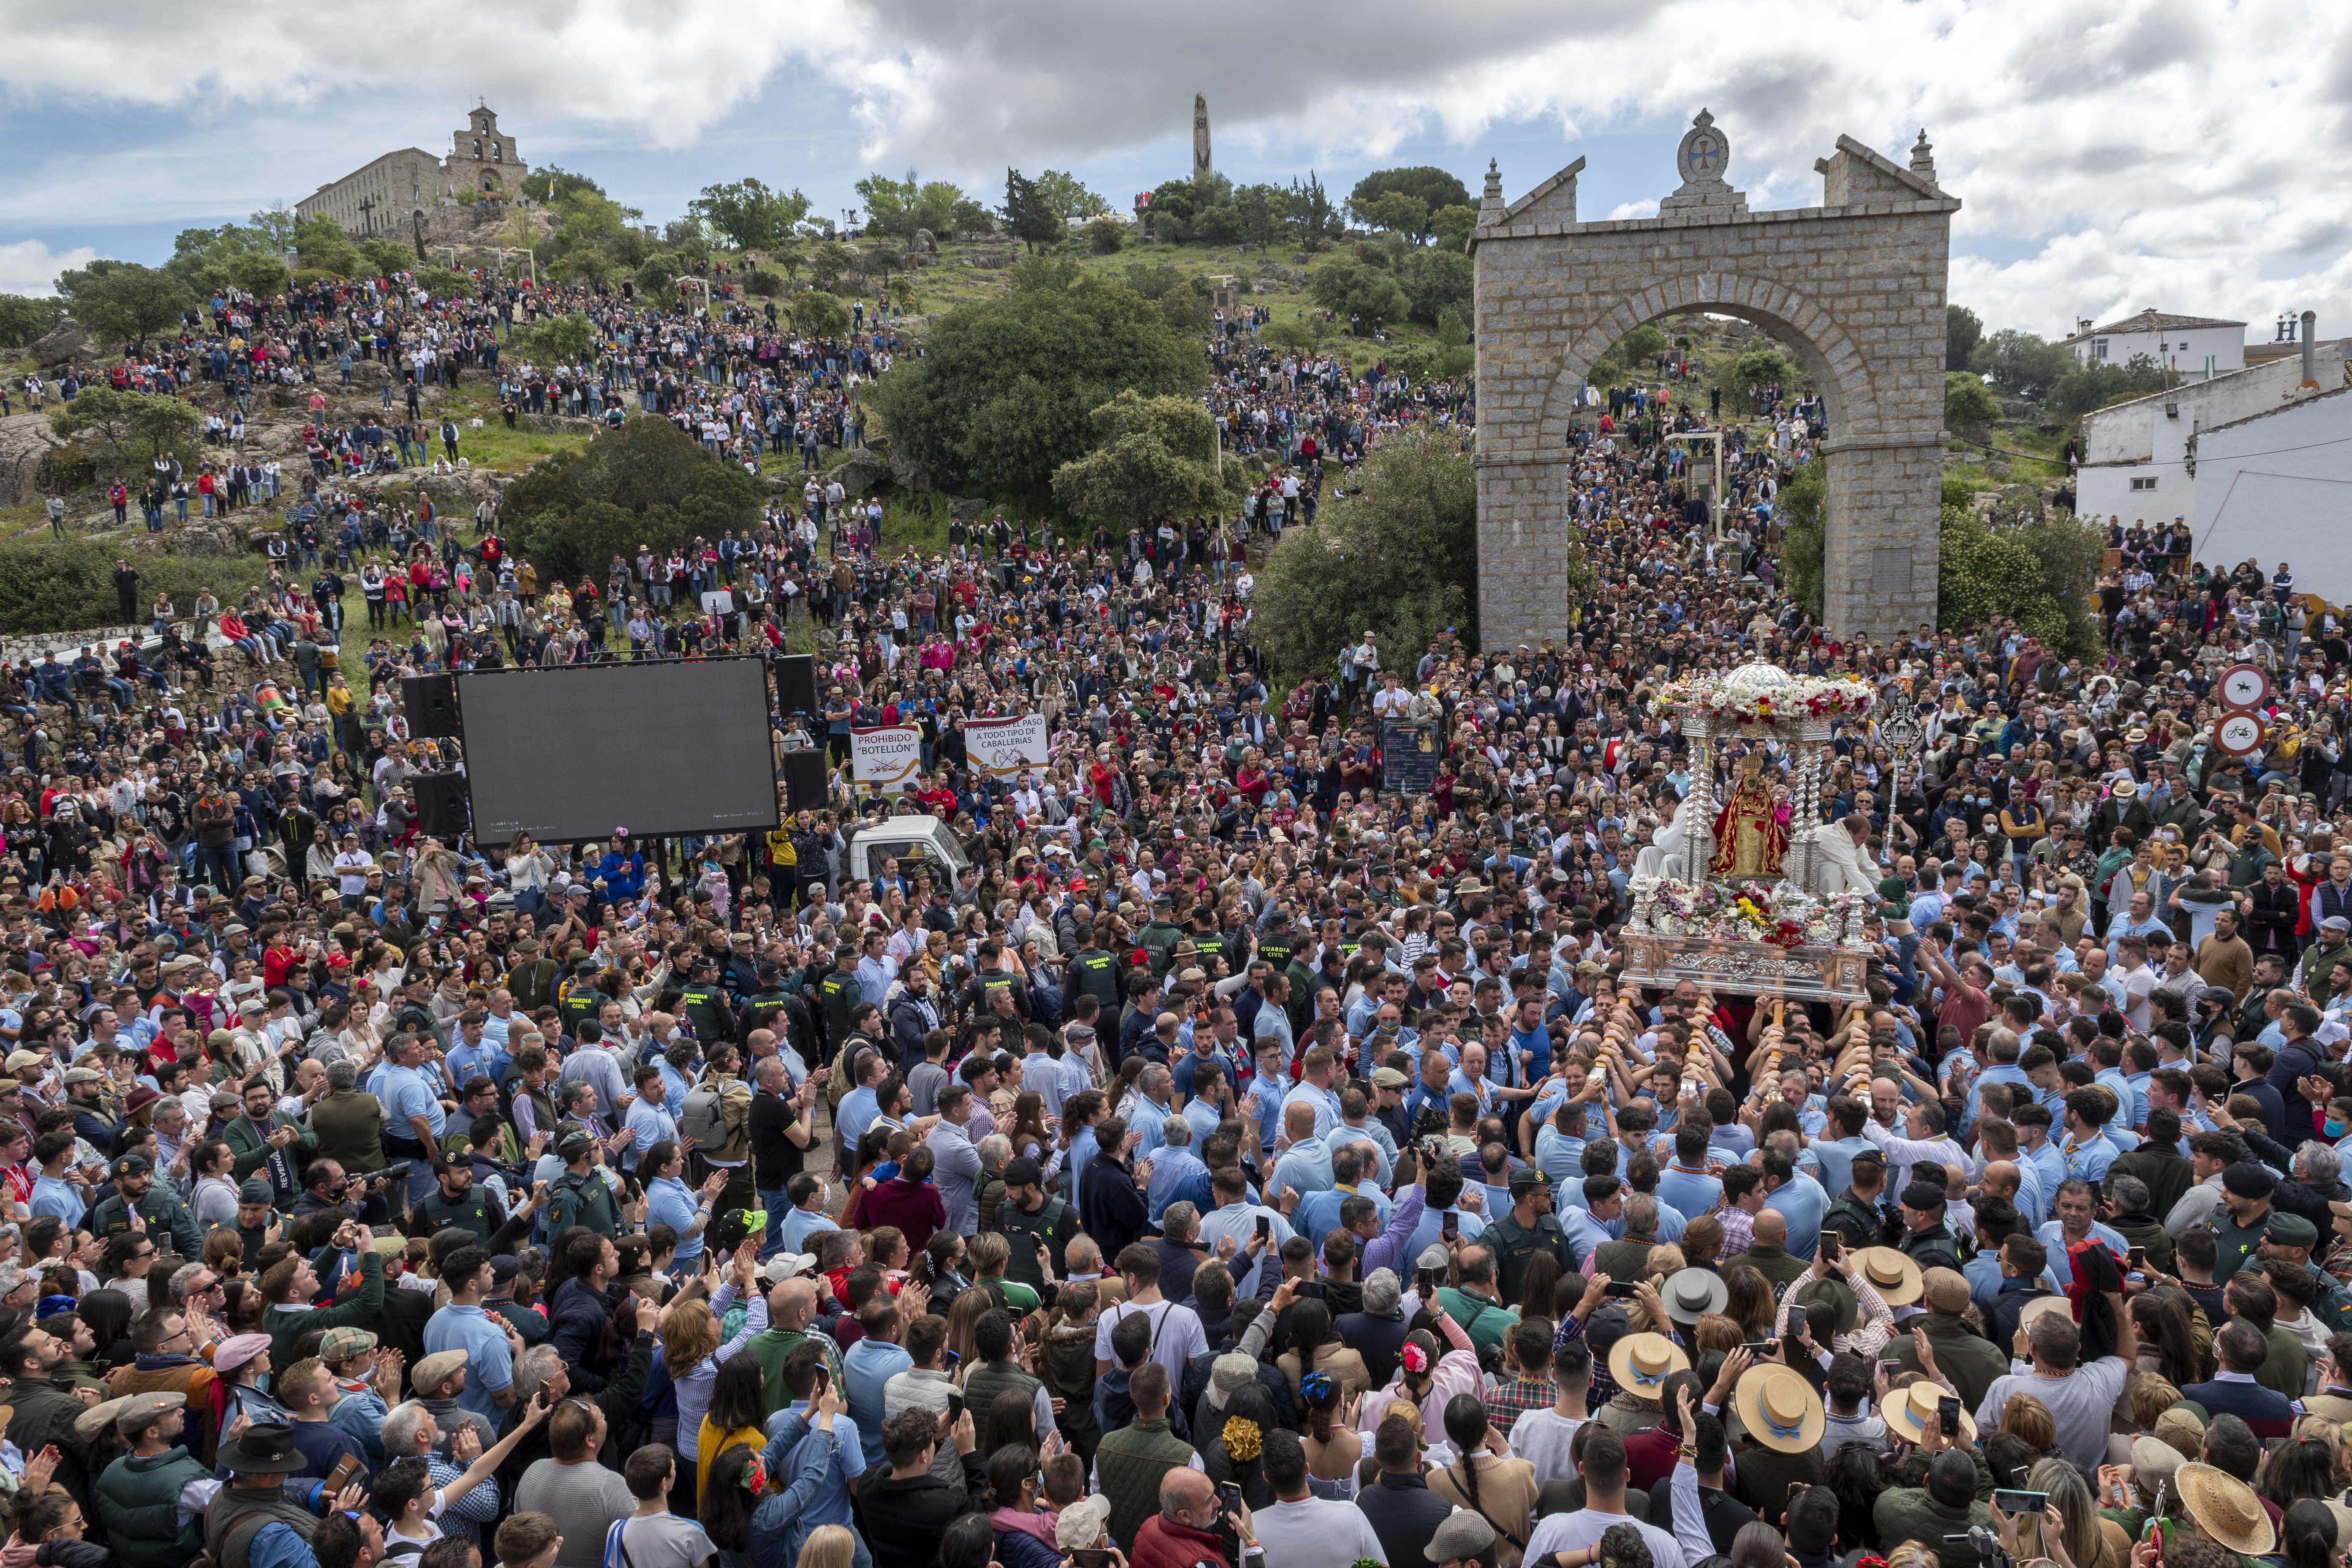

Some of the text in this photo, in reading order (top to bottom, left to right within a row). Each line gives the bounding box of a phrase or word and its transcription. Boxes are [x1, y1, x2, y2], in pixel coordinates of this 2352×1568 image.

[2275, 321, 2298, 341] H
[1023, 718, 1043, 726] PASO
[983, 731, 1005, 739] TODO
[1307, 780, 1317, 792] M
[1086, 957, 1110, 965] GUARDIA
[823, 980, 840, 989] GUARDIA
